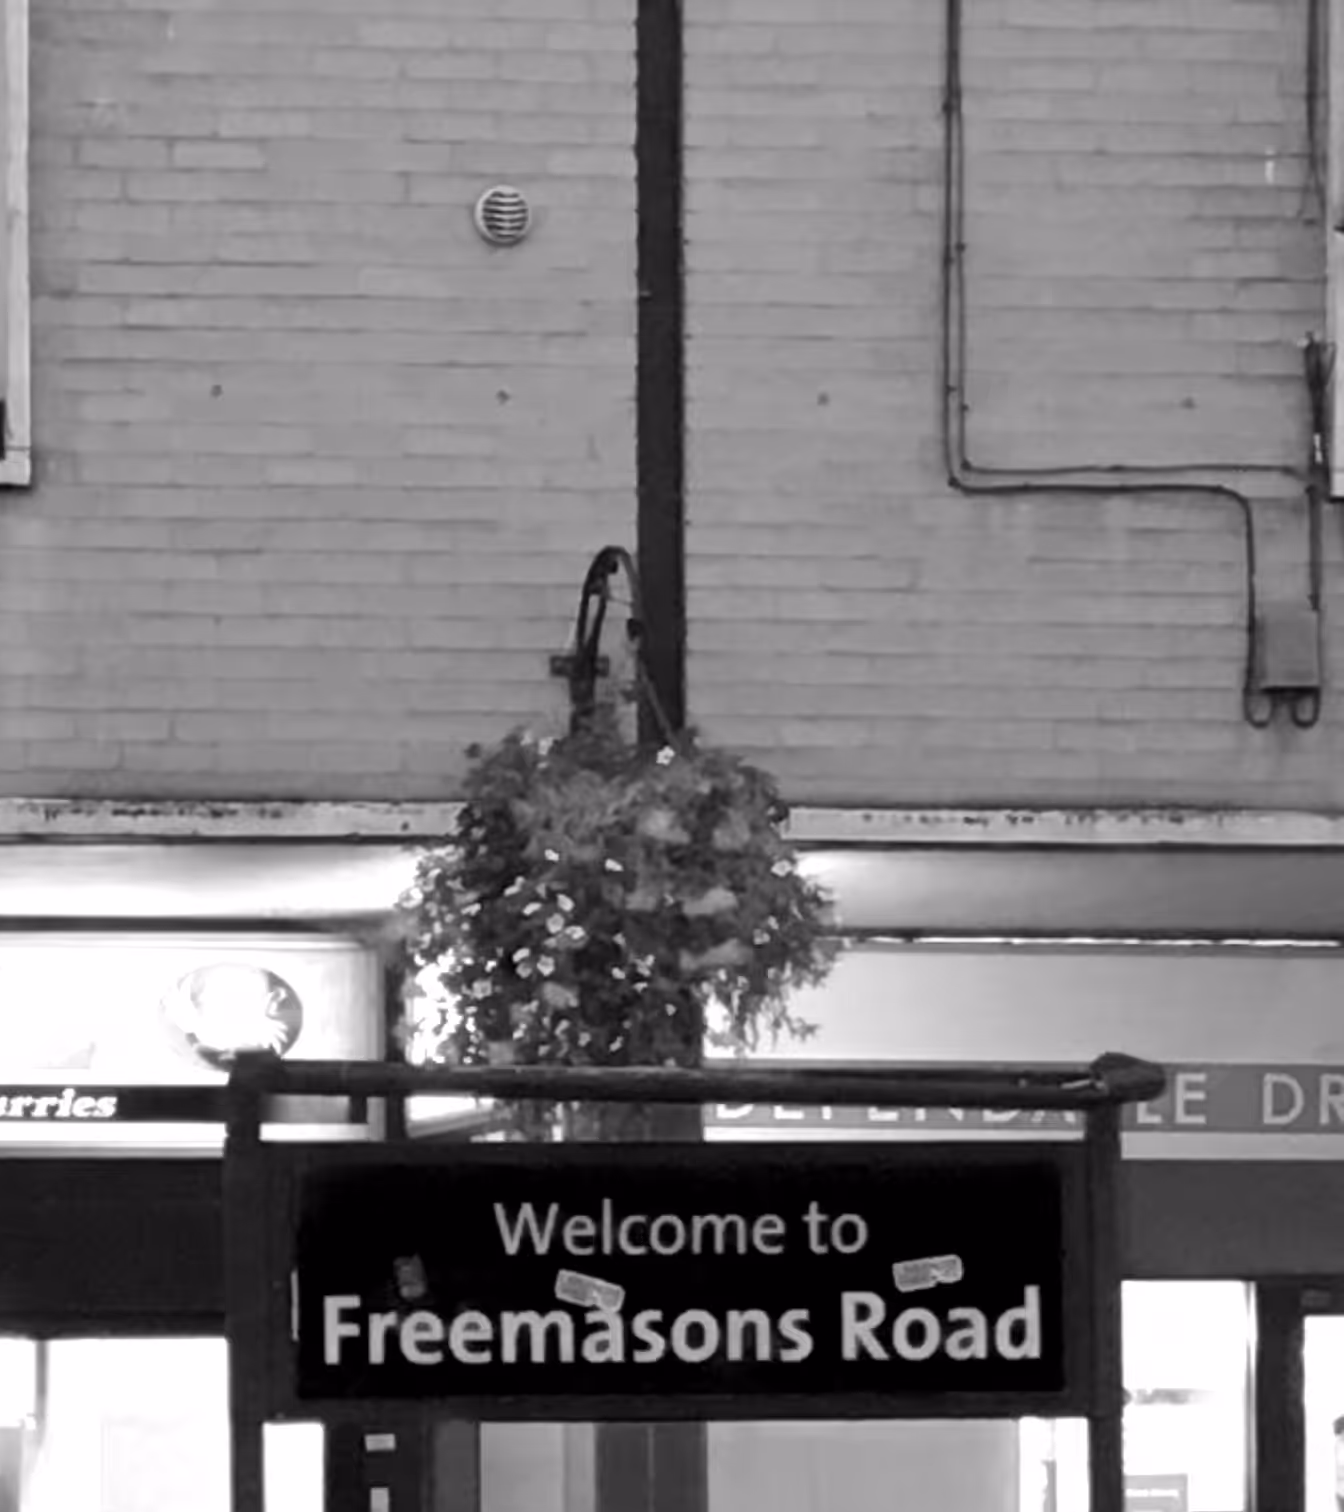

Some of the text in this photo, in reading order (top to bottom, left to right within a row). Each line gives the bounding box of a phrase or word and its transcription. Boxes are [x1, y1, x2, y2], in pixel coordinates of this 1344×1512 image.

[493, 1197, 869, 1256] Welcome to
[323, 1284, 1040, 1364] Freemasons Road
